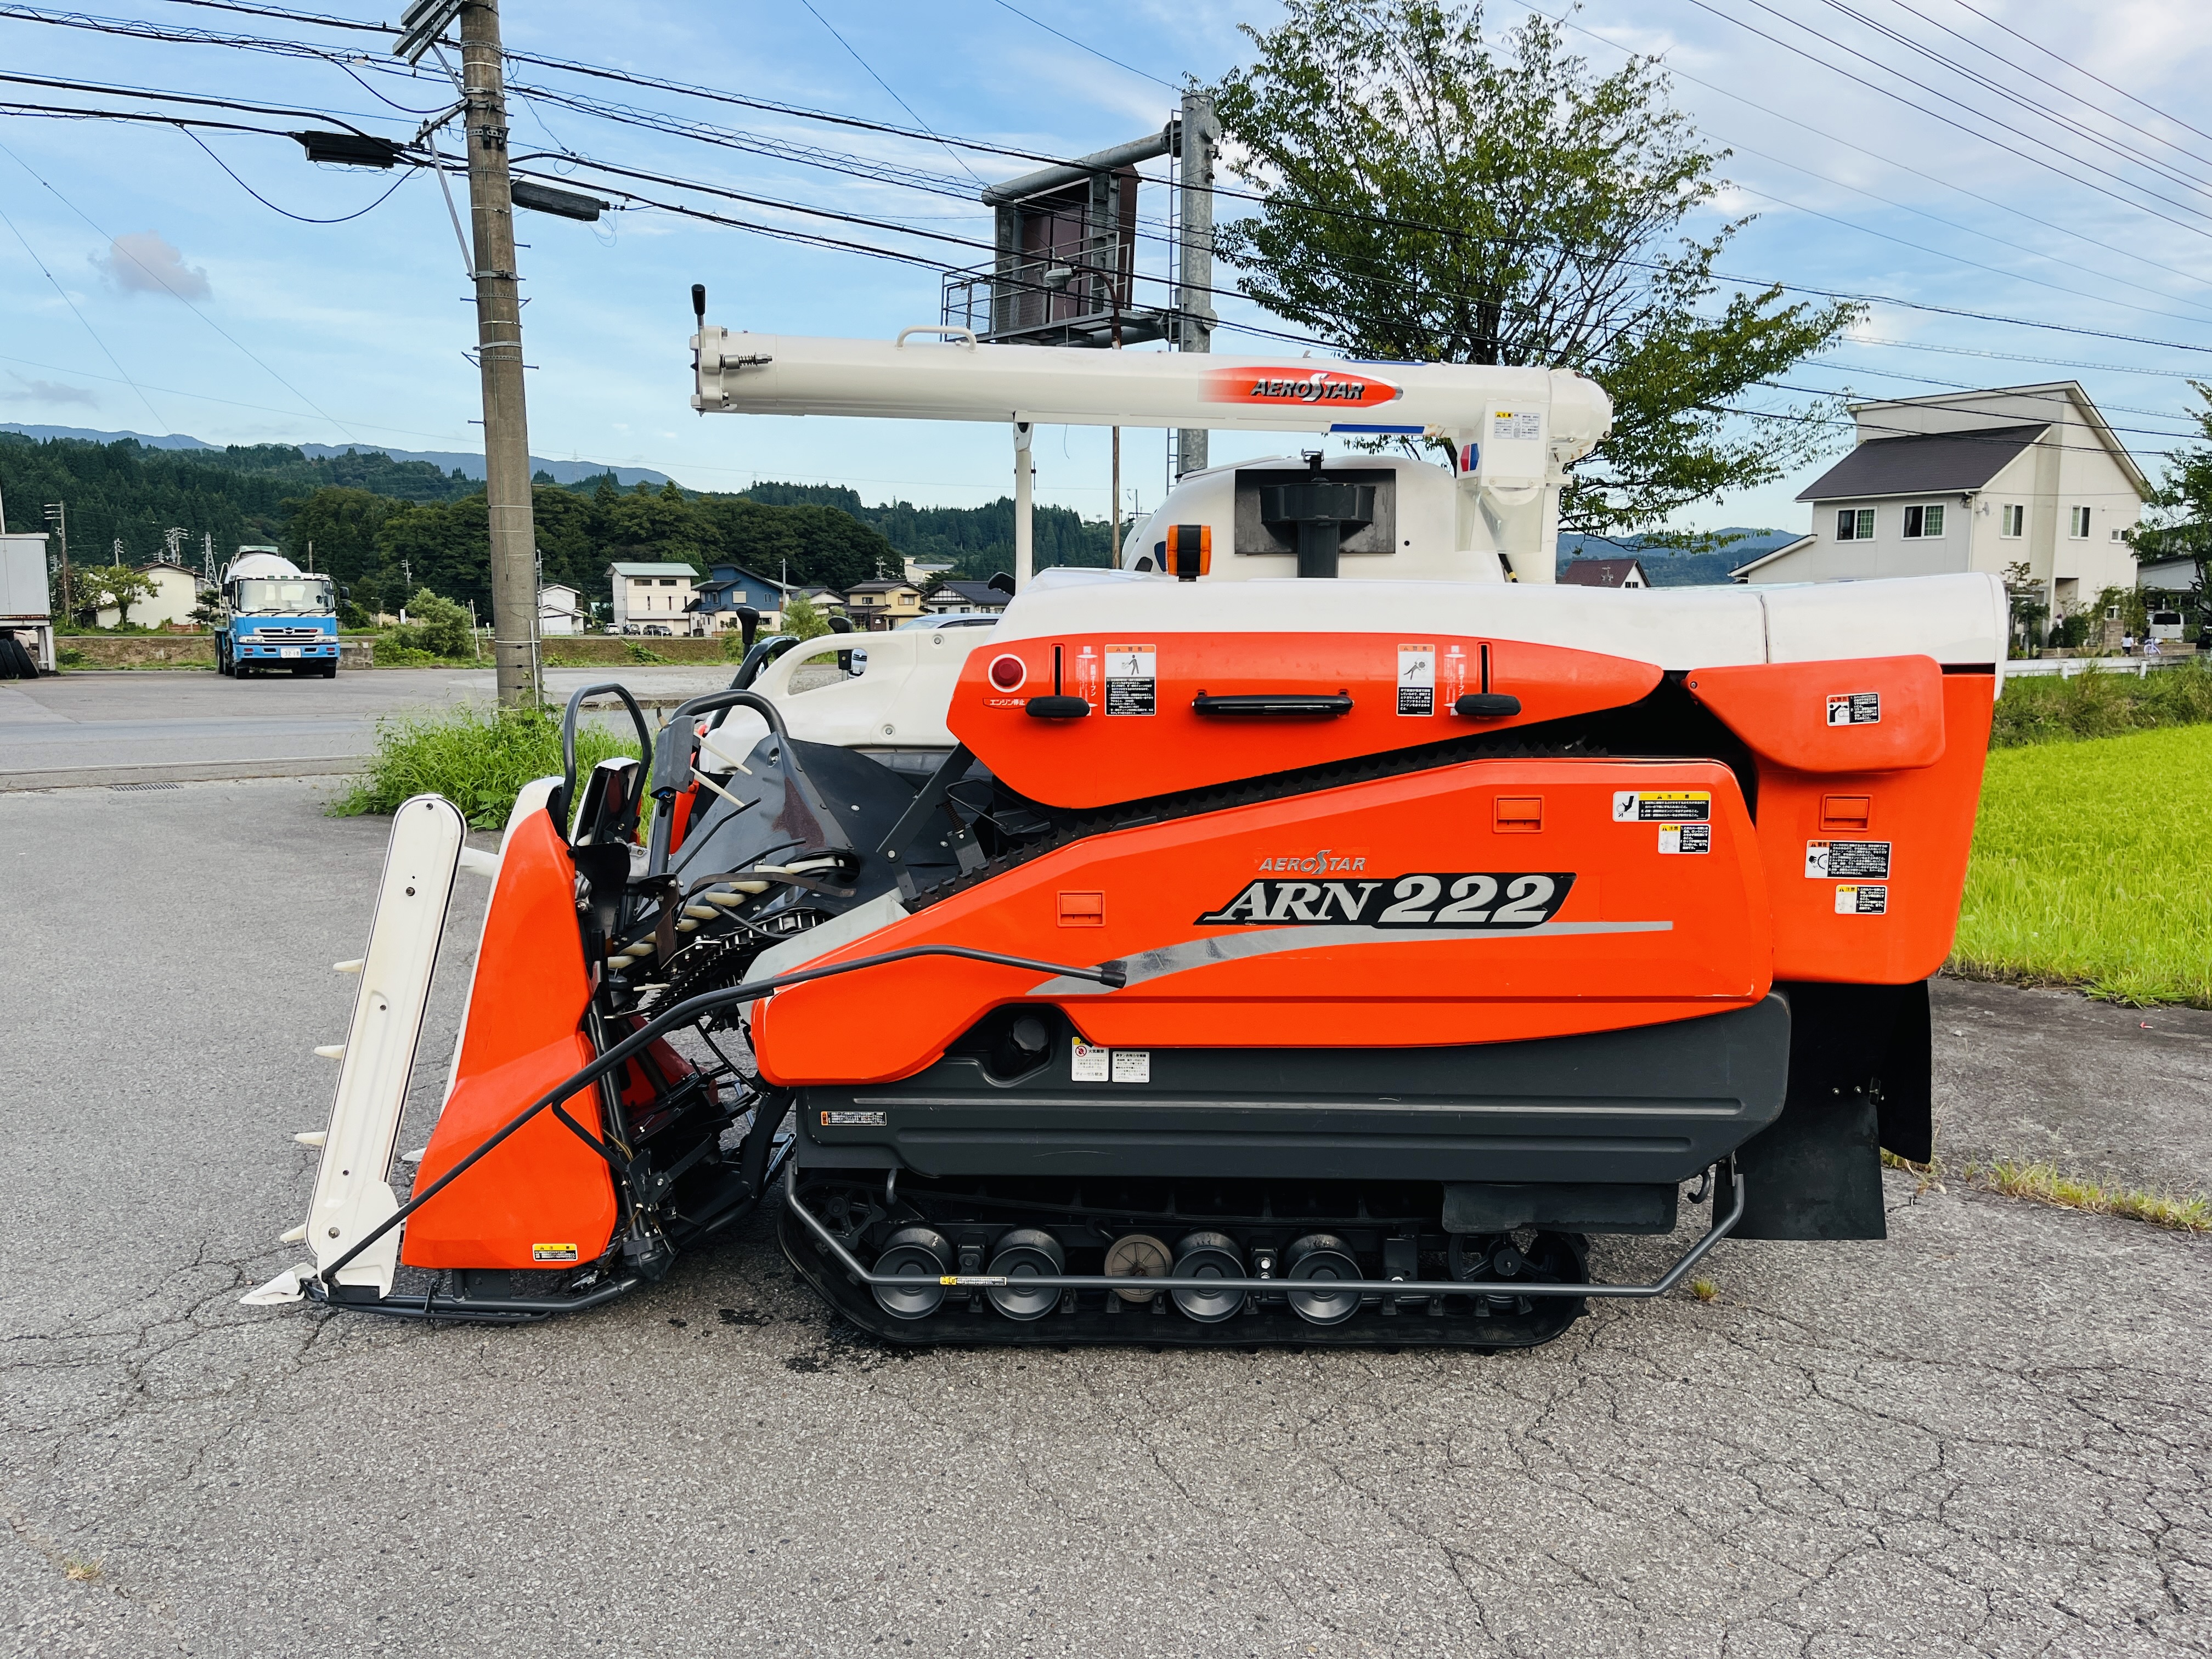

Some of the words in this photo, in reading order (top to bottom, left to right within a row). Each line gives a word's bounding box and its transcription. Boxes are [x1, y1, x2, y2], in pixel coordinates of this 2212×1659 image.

[1250, 373, 1365, 402] AEROSTAR
[1258, 849, 1366, 875] AEROSTAR
[1203, 882, 1383, 921] ARN
[1377, 875, 1555, 923] 222
